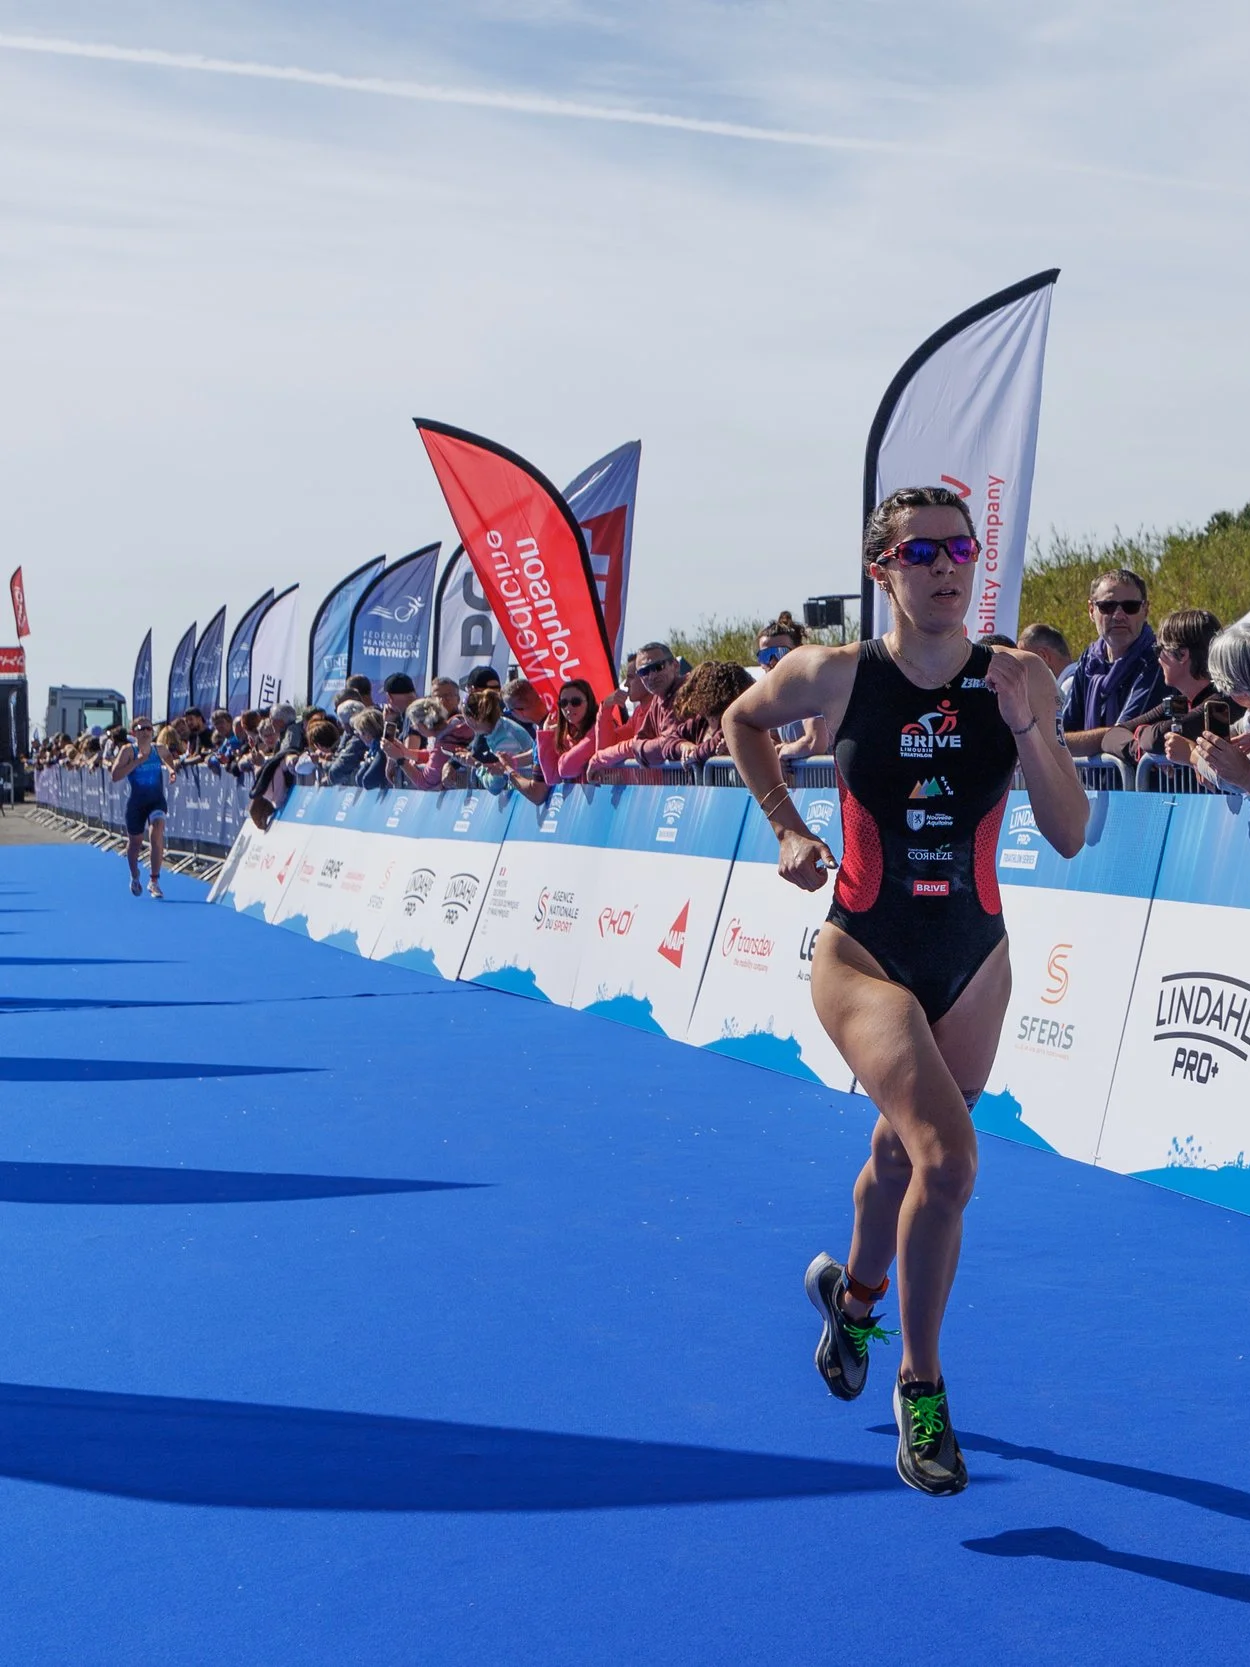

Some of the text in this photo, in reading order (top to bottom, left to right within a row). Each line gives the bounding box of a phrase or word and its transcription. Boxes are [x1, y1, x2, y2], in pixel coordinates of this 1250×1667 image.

[978, 474, 1006, 635] bility company
[362, 646, 420, 659] TRIATHLON
[1010, 810, 1036, 830] LINDA
[916, 884, 946, 892] BRIVE
[552, 890, 575, 904] AGENCE
[549, 905, 580, 920] NATIONALE
[553, 919, 573, 933] SPORT
[737, 932, 775, 957] transdev
[1171, 1047, 1219, 1085] PRO+
